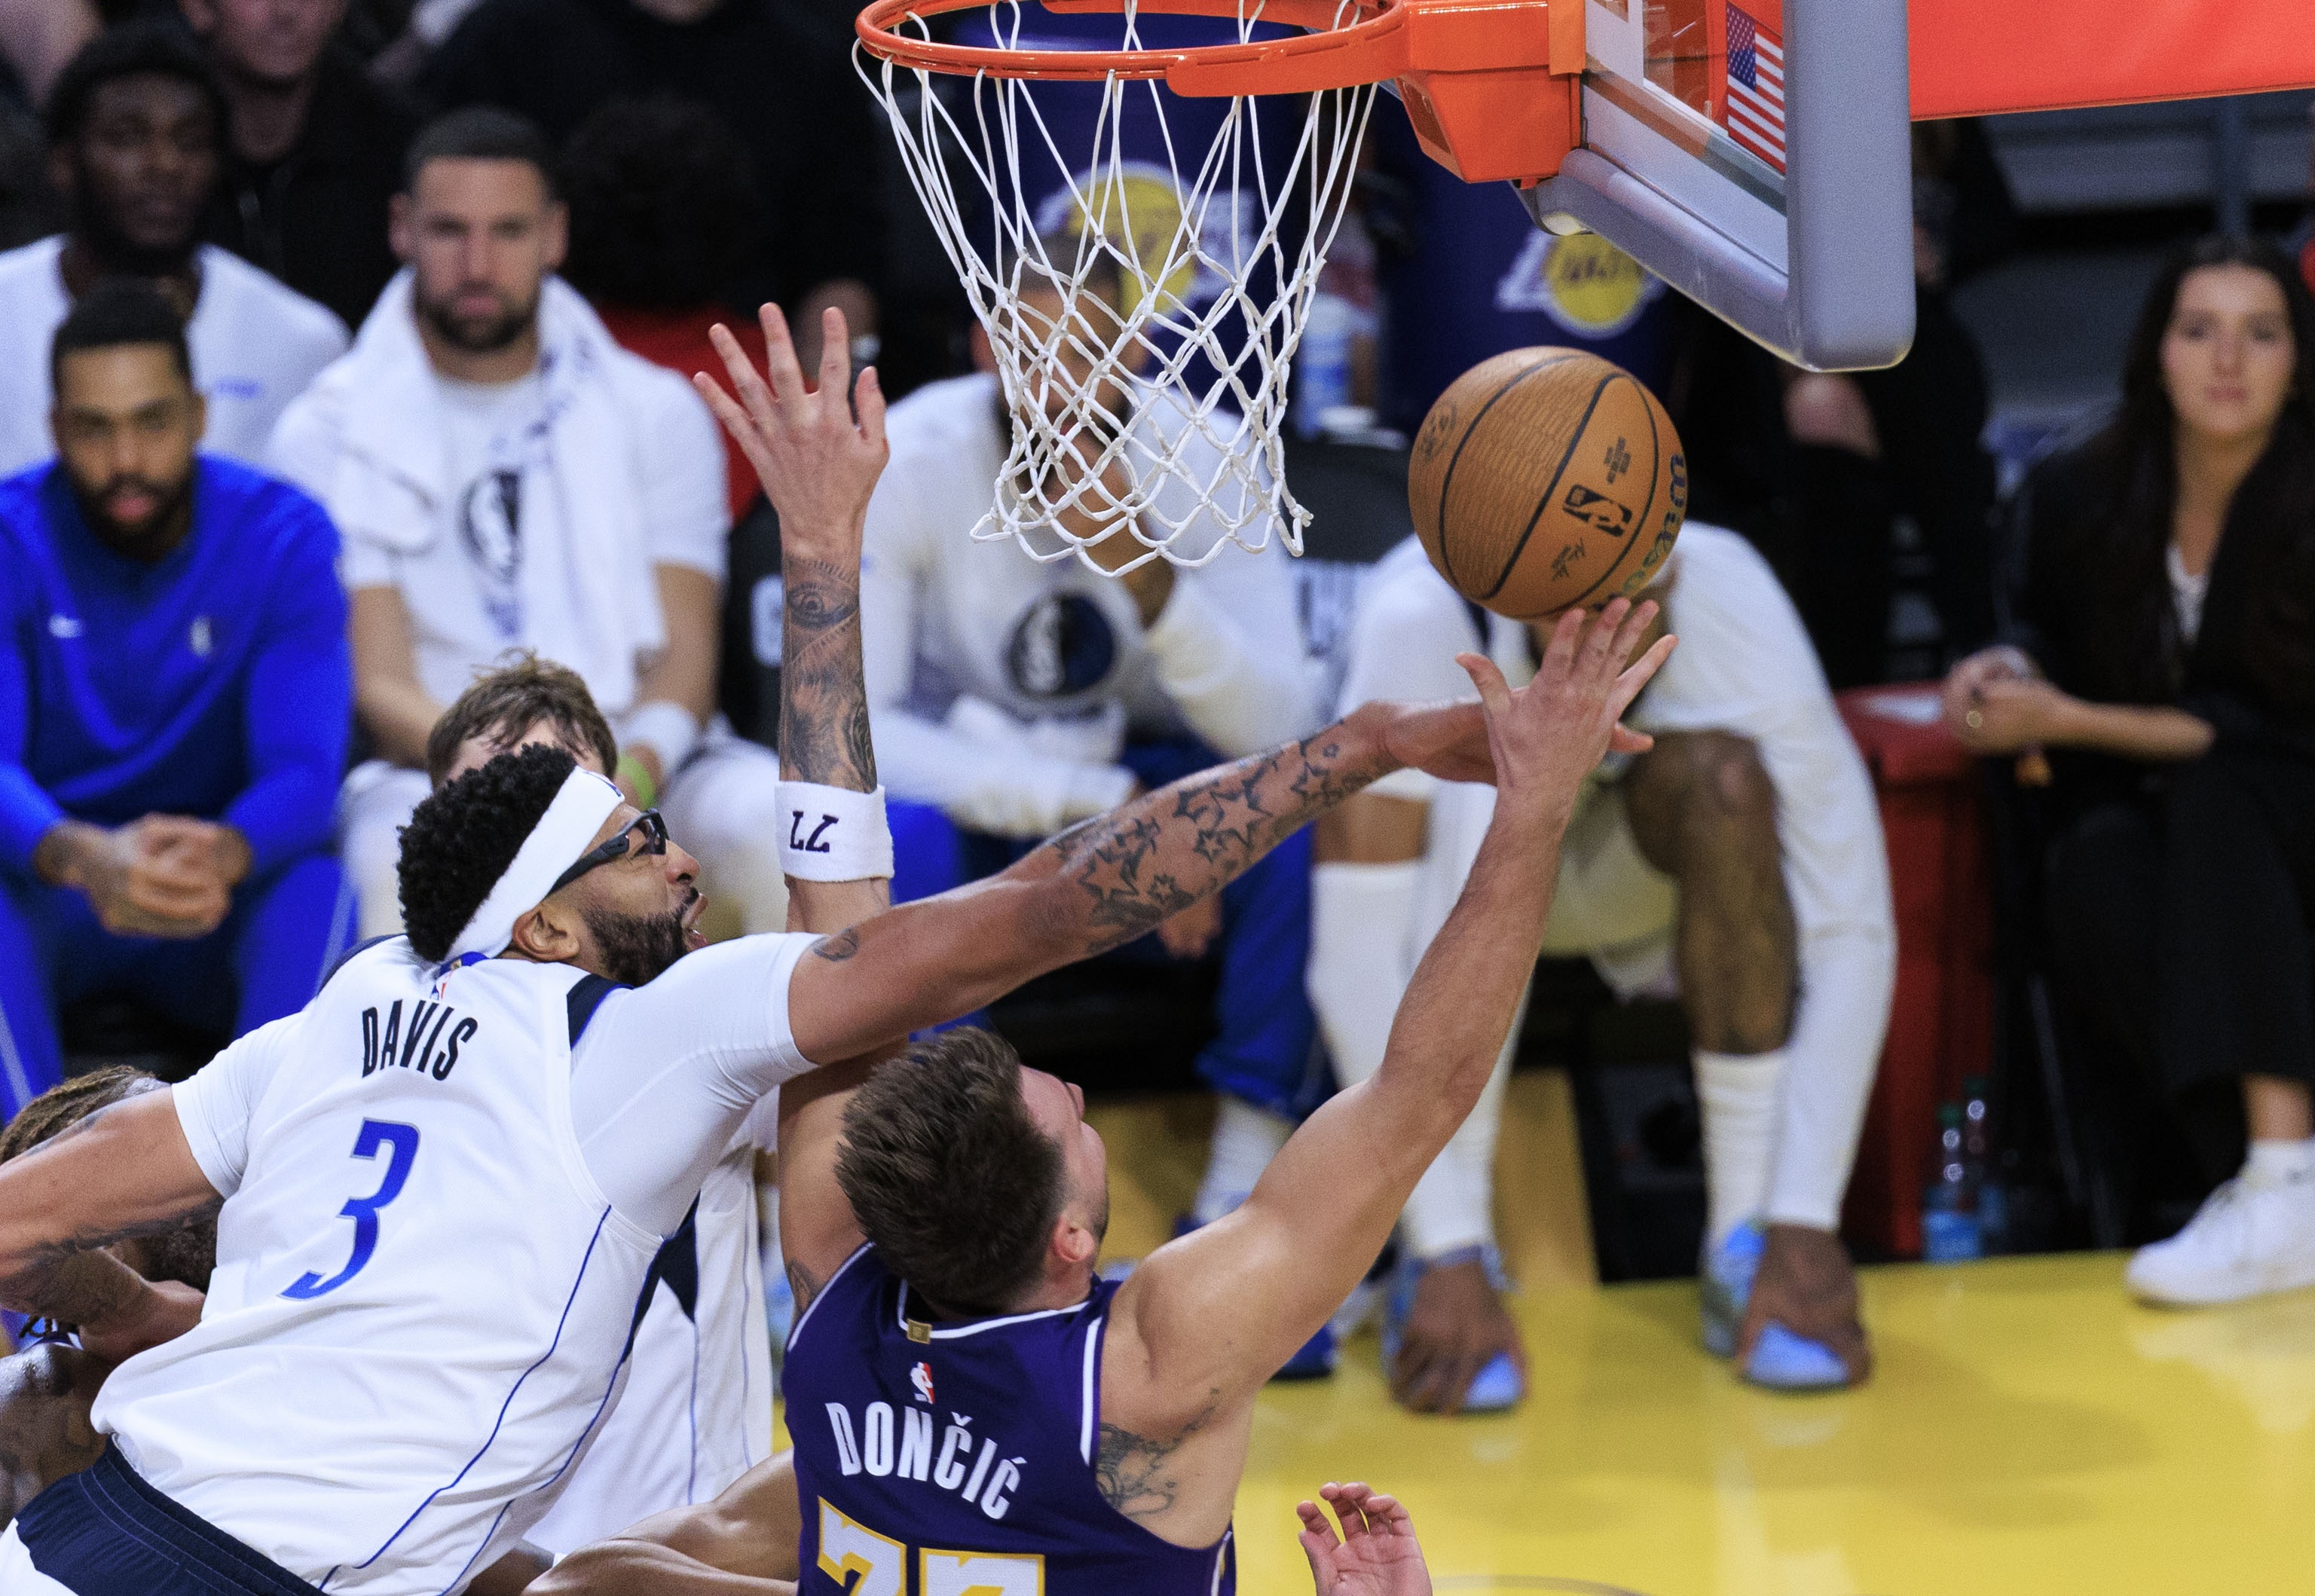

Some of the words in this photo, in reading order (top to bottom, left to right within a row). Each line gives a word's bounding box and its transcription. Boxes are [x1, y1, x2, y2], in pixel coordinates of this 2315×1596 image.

[1610, 453, 1687, 601] Wilso
[362, 998, 478, 1081] DAVIS
[277, 1116, 421, 1301] 3
[825, 1401, 1027, 1520] DONČIĆ
